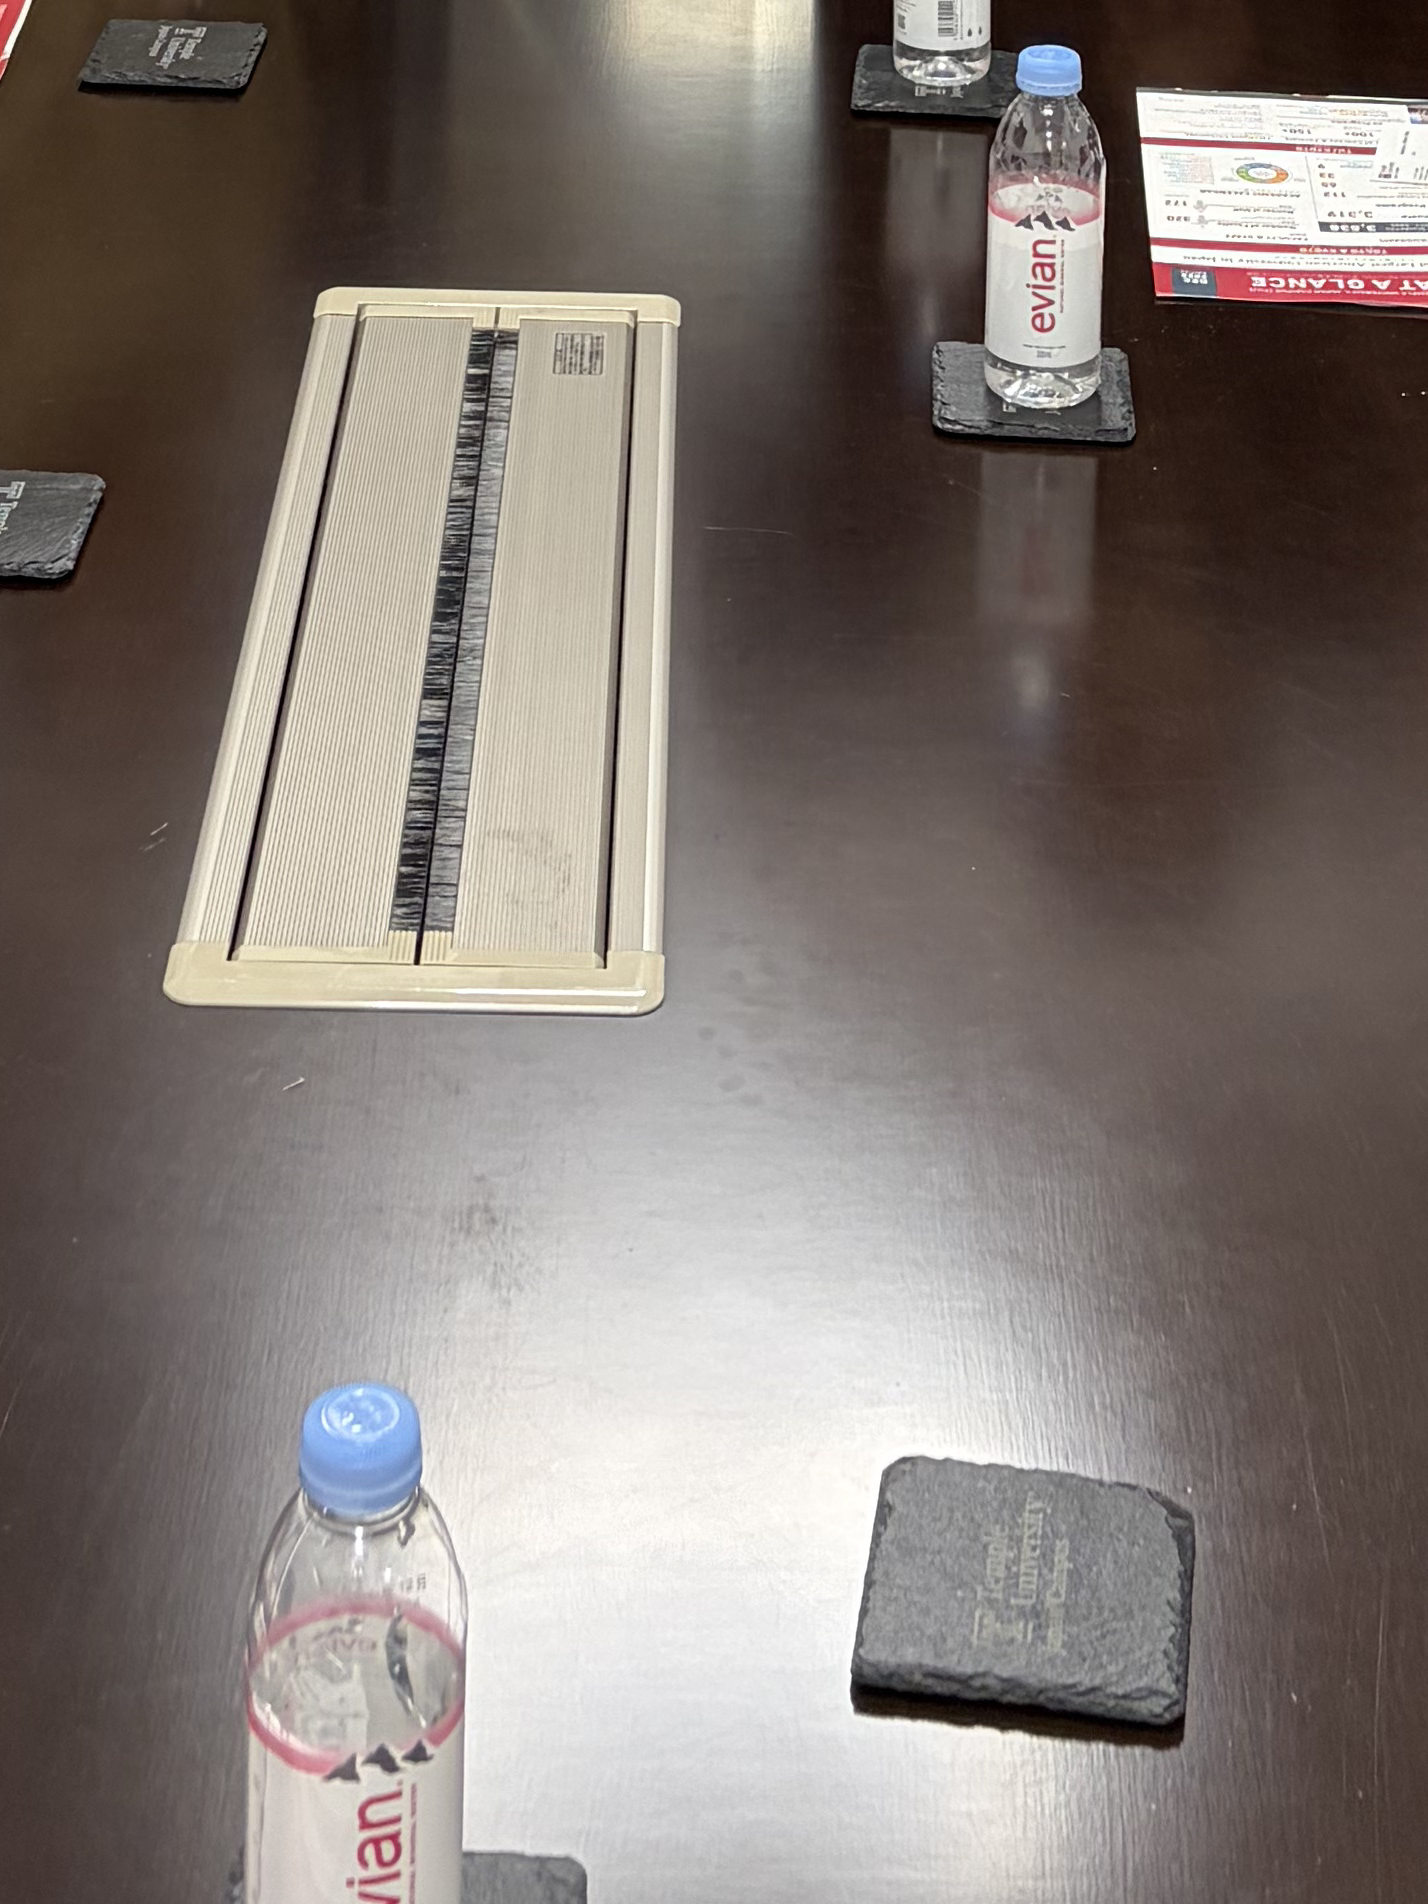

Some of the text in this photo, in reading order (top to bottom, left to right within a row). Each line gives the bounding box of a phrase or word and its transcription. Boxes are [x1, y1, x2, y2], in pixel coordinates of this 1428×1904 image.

[1025, 239, 1056, 333] evian
[1250, 277, 1365, 290] GLANCE
[1372, 279, 1391, 290] A
